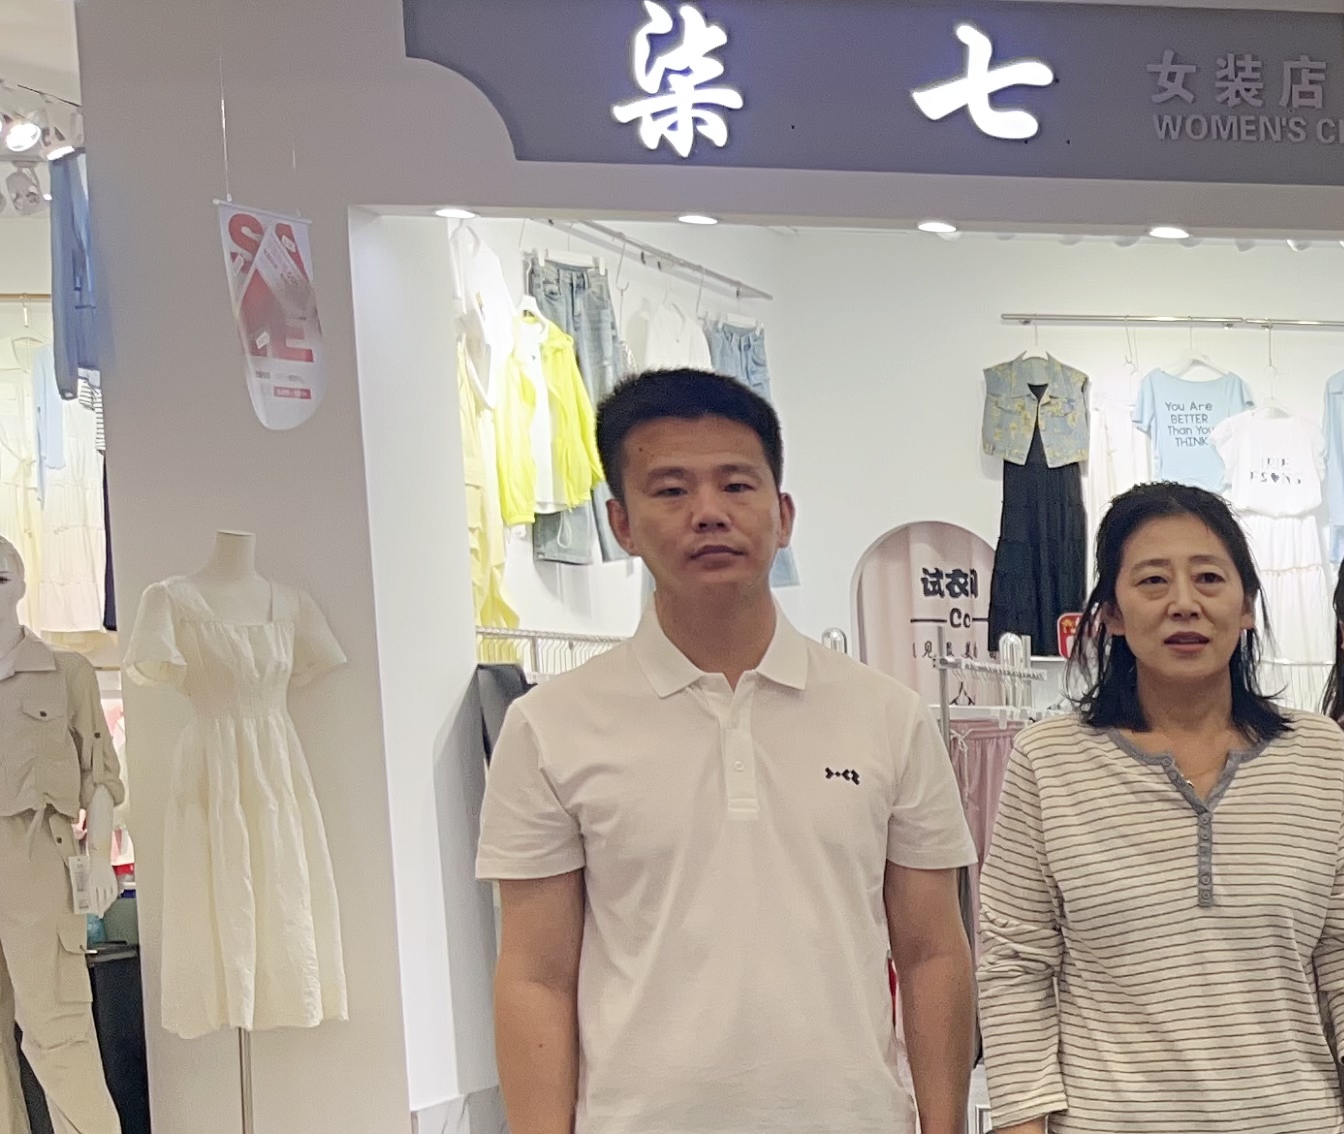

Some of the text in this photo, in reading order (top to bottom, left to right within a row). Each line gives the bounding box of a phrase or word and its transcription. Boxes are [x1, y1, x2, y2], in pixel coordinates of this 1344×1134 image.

[1147, 50, 1327, 109] 女装店
[1153, 114, 1307, 143] WOMEN'S
[1165, 401, 1213, 412] You Are
[1170, 414, 1208, 425] BETTER
[1168, 426, 1193, 436] Than
[1175, 437, 1208, 448] THINK
